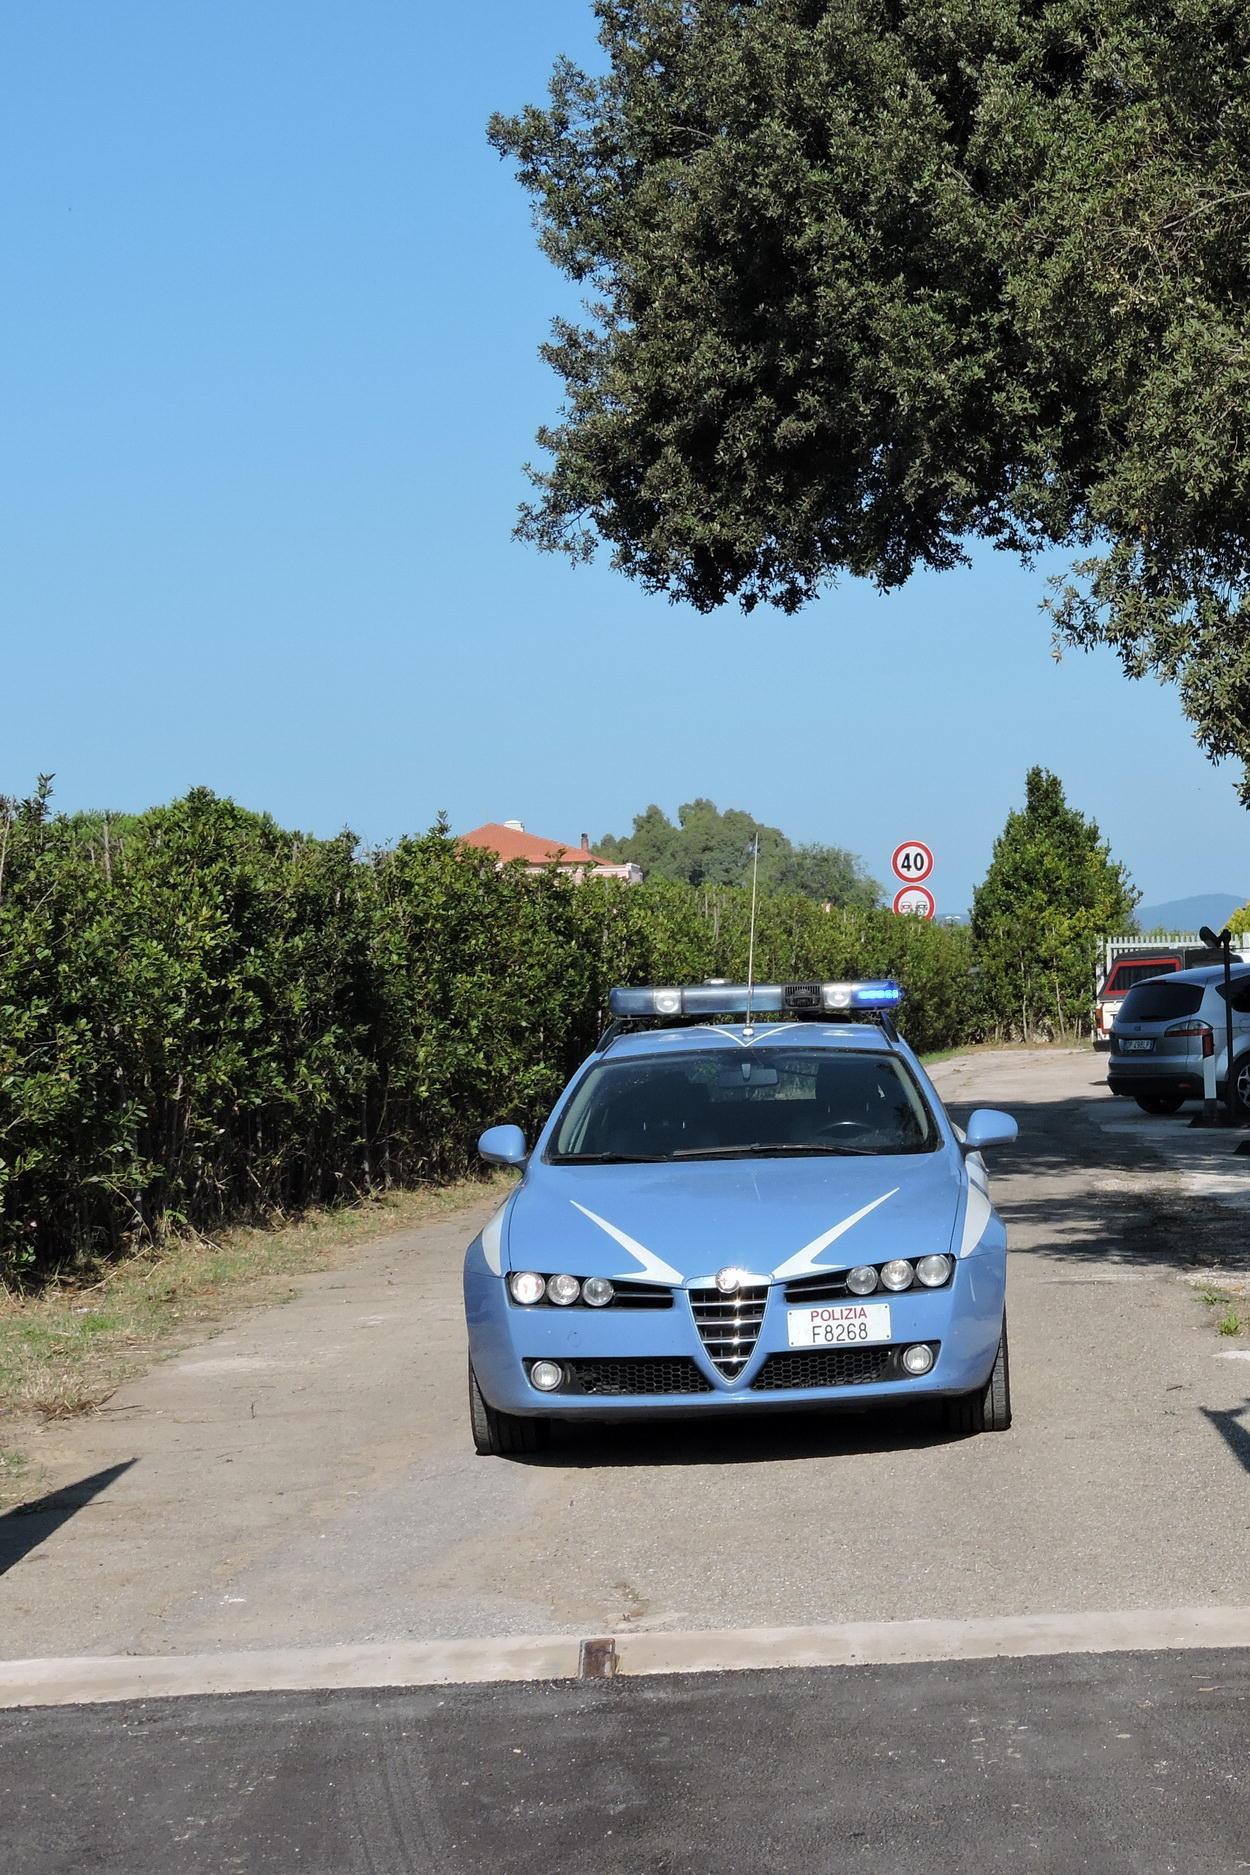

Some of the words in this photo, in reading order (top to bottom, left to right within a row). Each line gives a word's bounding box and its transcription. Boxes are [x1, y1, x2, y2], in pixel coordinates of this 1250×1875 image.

[901, 852, 924, 871] 40
[811, 1307, 867, 1322] POLIZIA
[812, 1322, 868, 1343] F8268
